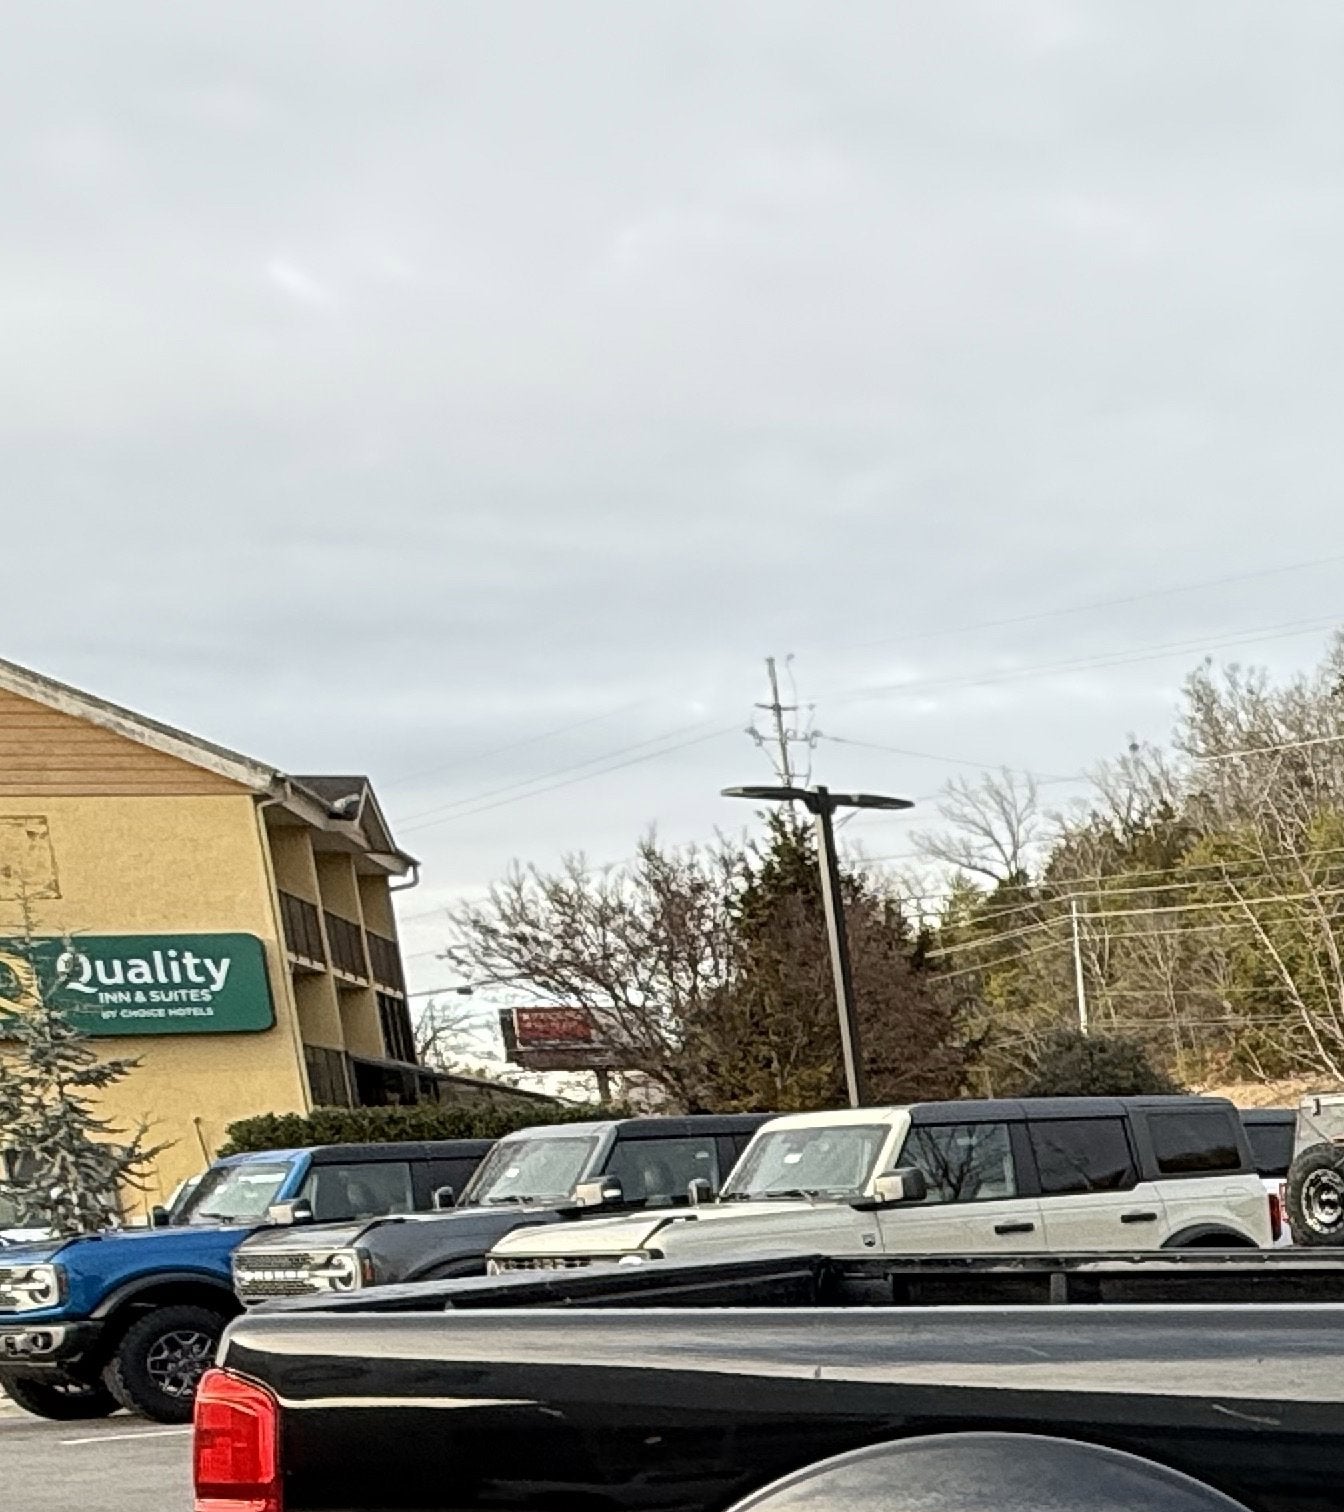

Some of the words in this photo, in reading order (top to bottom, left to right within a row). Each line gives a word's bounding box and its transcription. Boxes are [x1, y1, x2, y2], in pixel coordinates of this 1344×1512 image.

[57, 950, 230, 993] Quality
[99, 991, 131, 1004] INN
[149, 988, 212, 1002] SUITES
